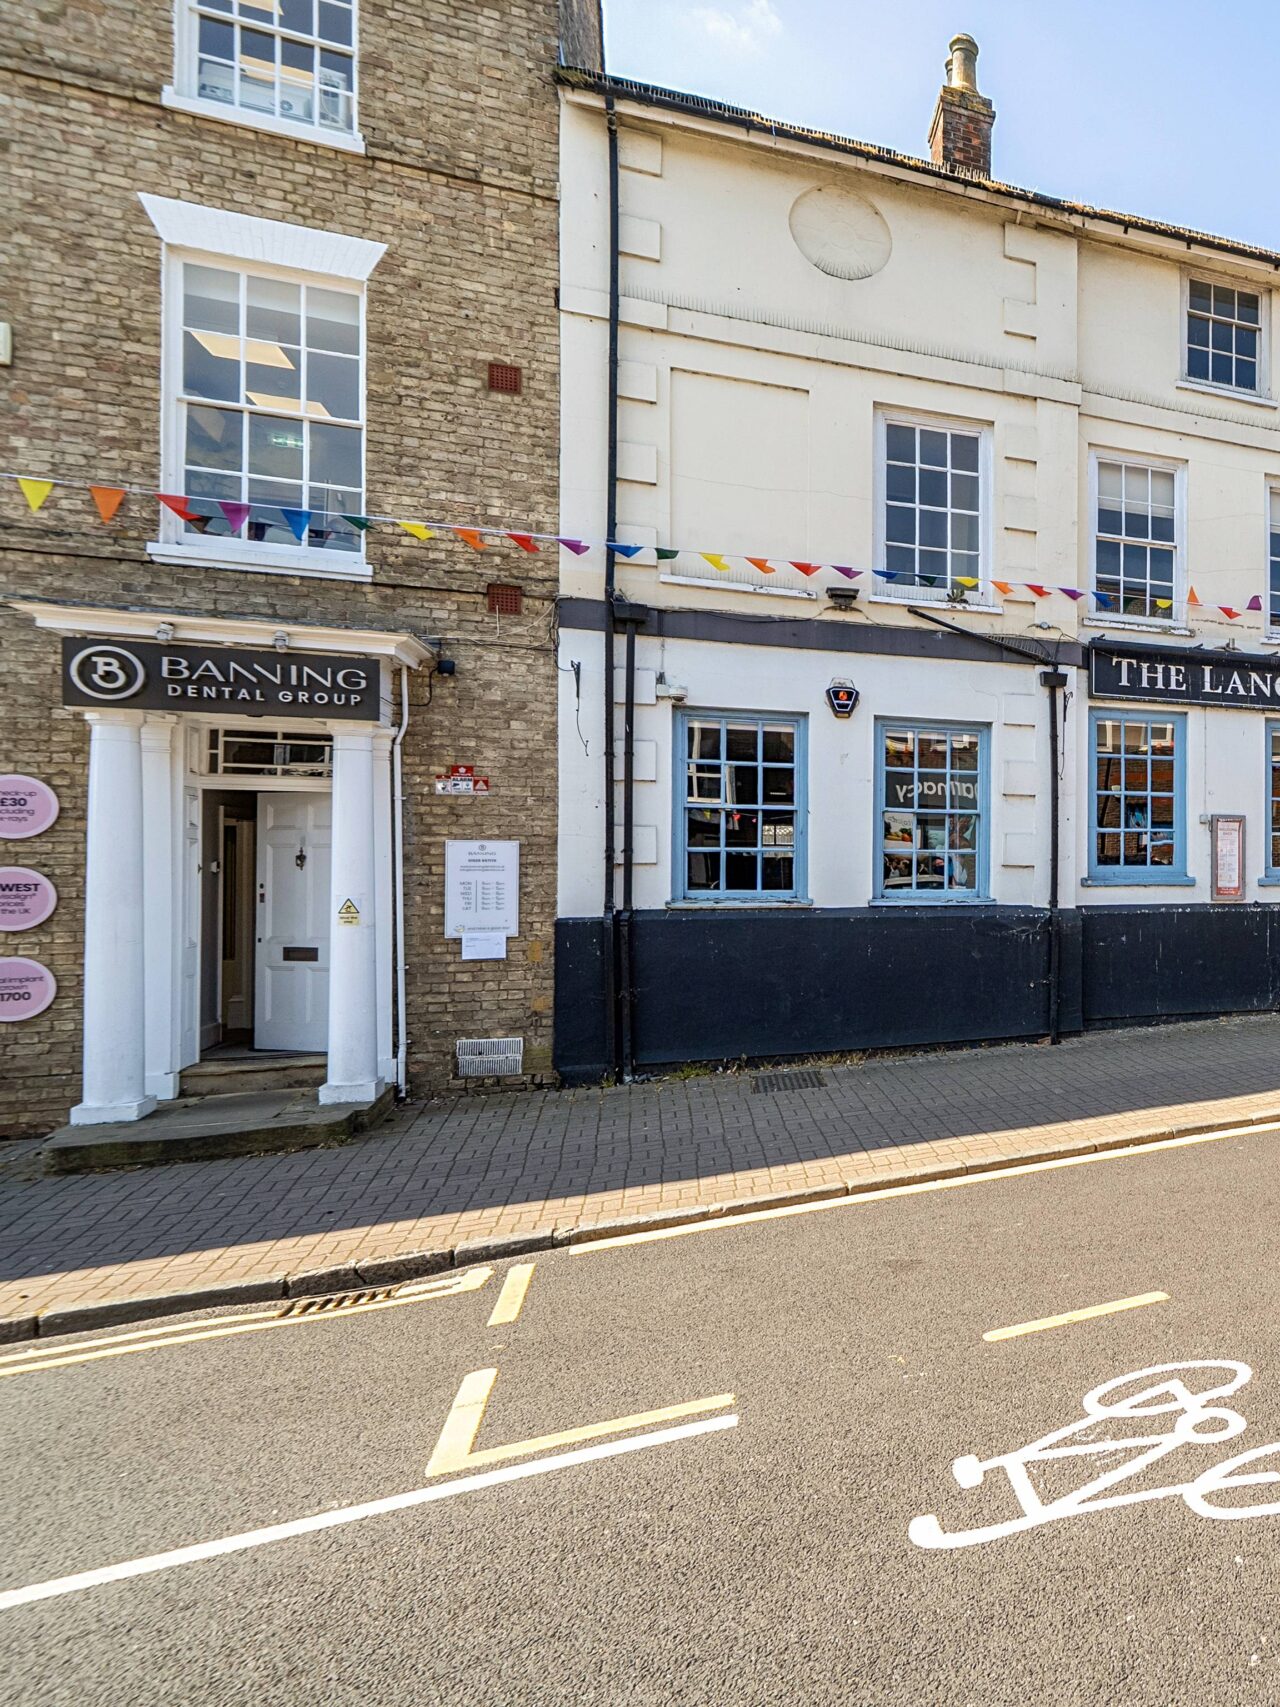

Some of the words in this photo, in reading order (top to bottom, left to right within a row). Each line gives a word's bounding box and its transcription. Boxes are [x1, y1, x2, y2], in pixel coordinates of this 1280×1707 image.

[161, 655, 368, 690] BANNING
[1112, 657, 1187, 691] THE
[167, 683, 265, 702] DENTAL
[278, 690, 362, 706] GROUP
